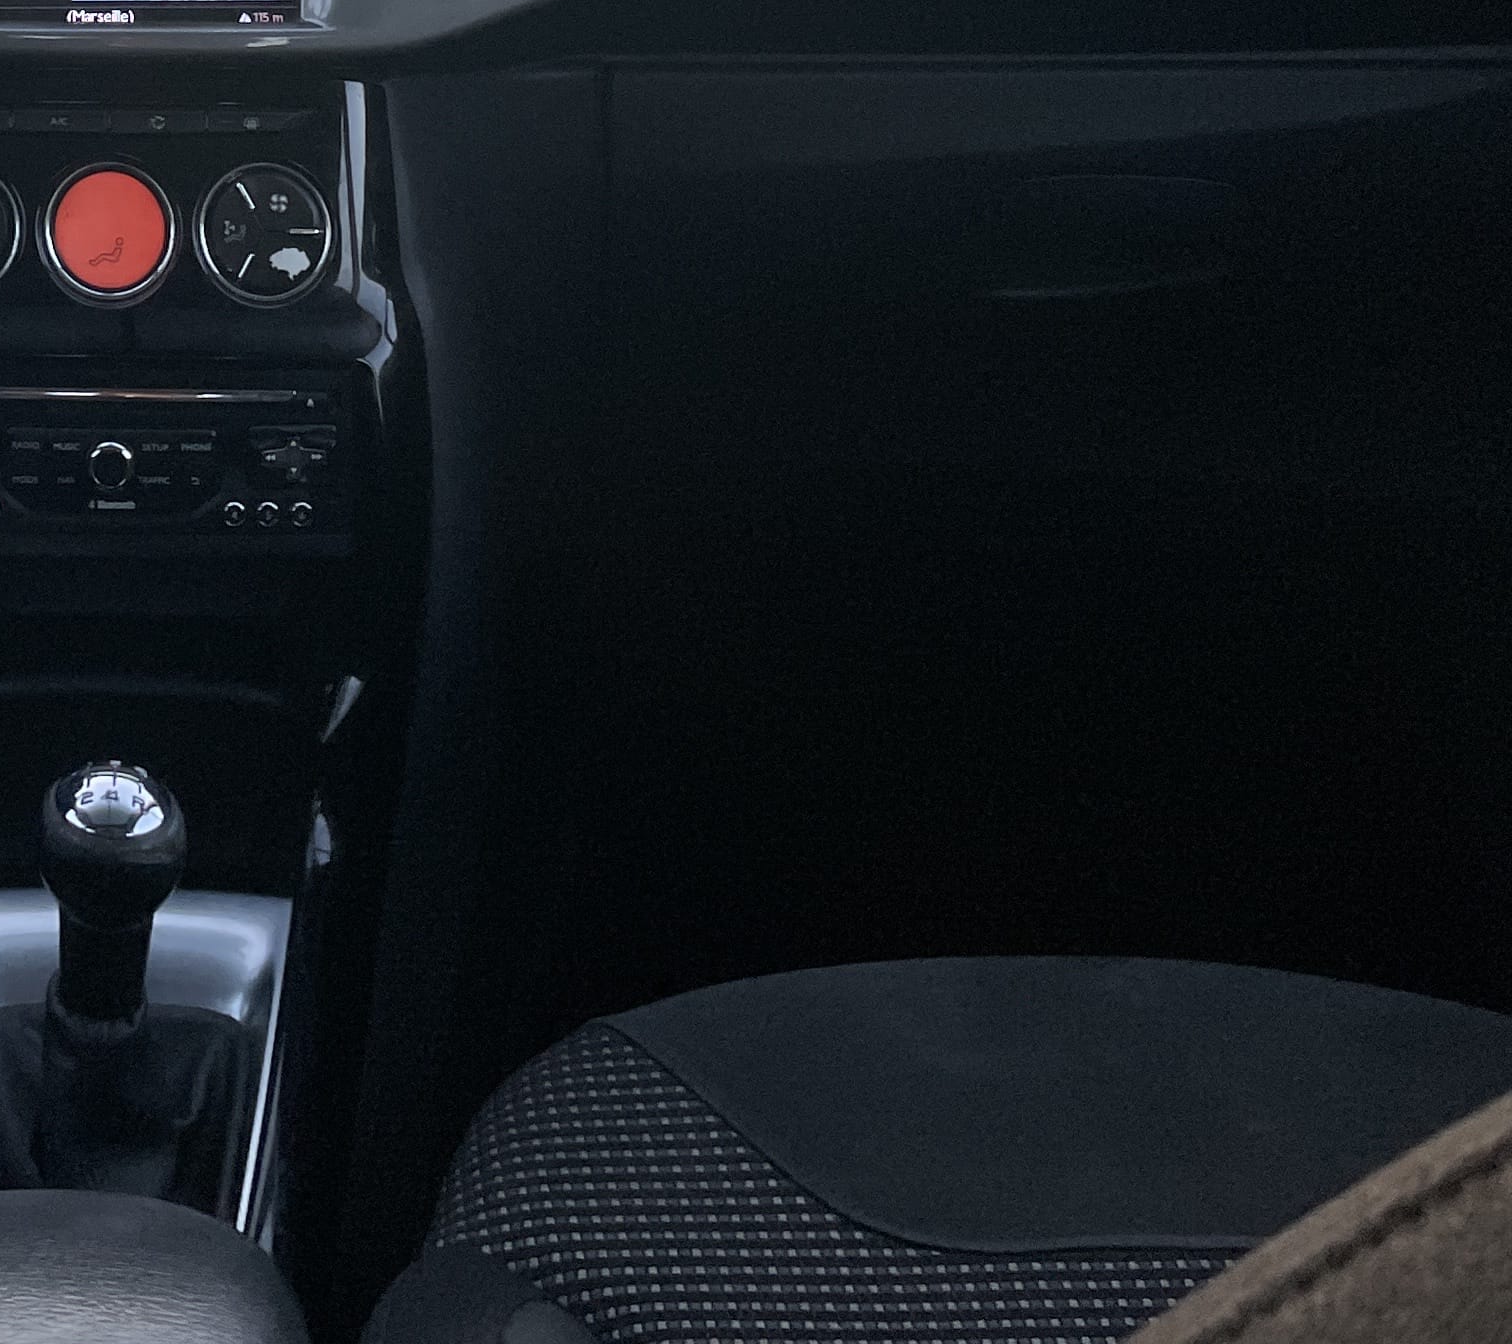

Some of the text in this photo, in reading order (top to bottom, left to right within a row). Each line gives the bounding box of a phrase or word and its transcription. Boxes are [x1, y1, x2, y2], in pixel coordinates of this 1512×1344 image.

[66, 10, 134, 23] (Marseille)
[252, 13, 270, 22] 115
[80, 791, 94, 805] 2
